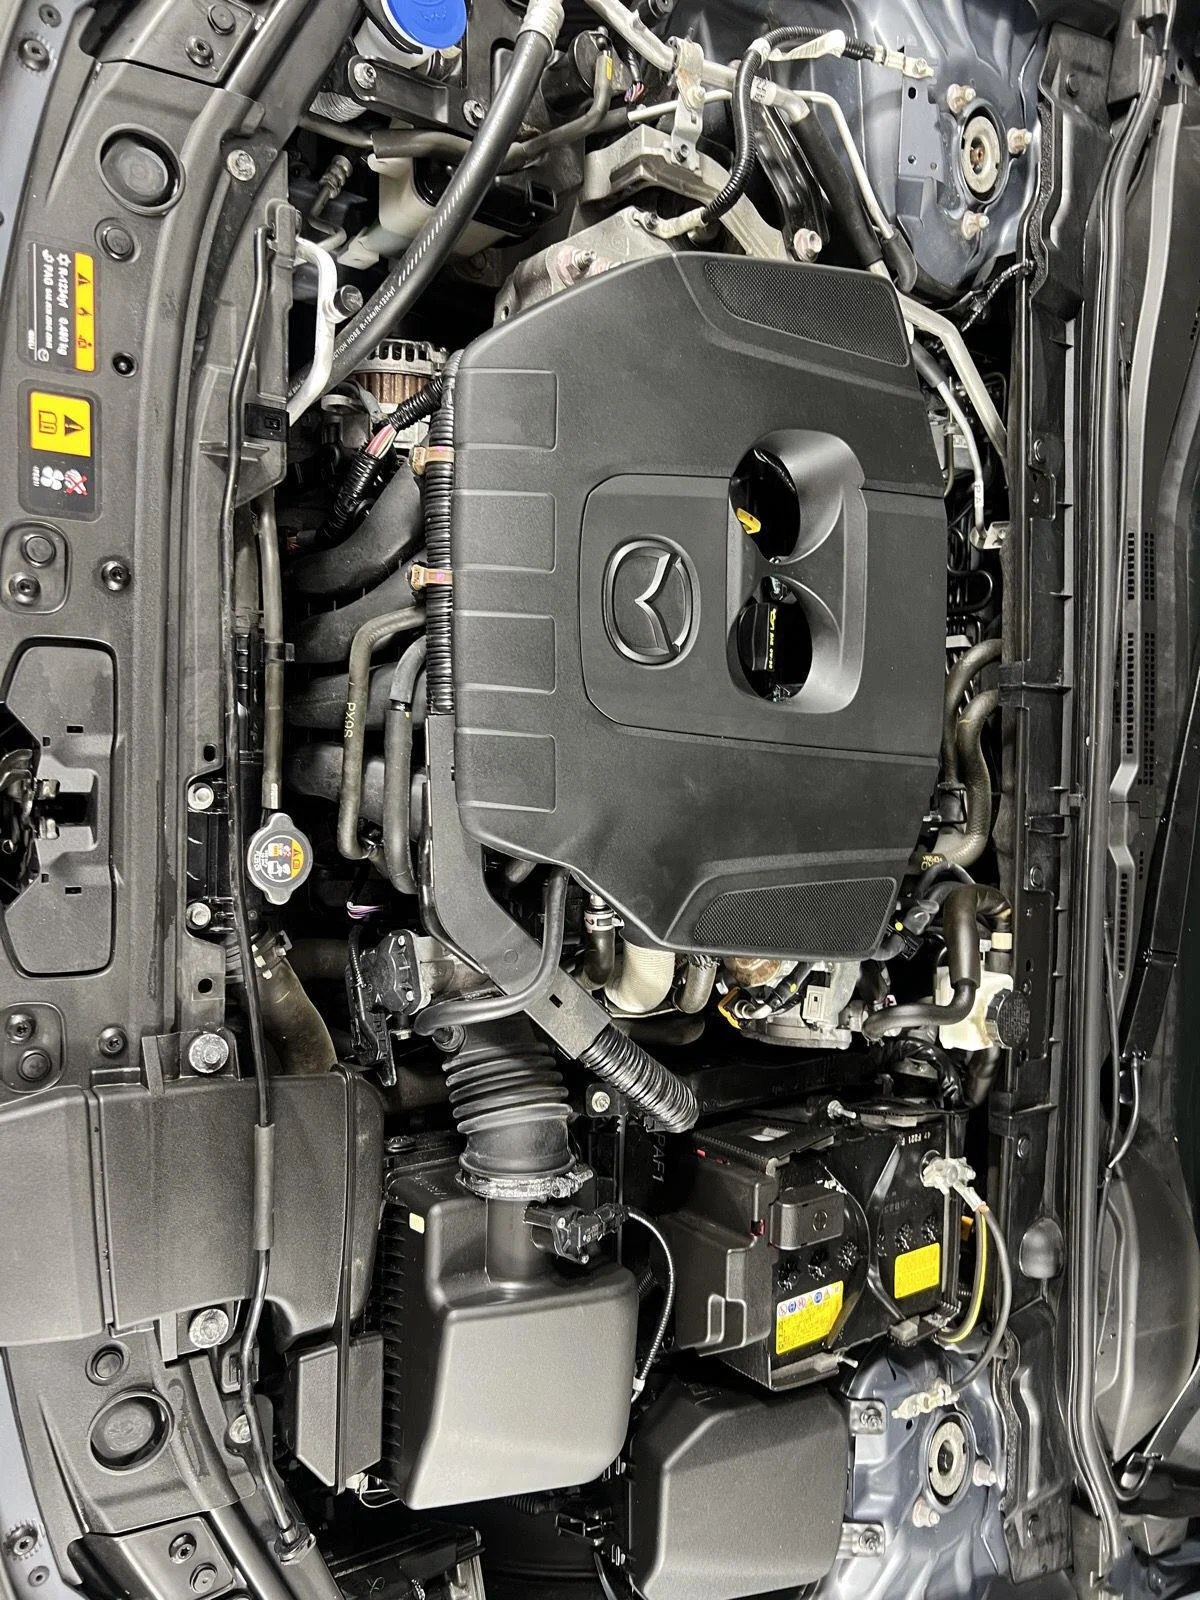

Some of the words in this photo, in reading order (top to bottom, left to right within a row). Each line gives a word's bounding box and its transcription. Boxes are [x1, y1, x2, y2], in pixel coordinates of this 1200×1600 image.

[43, 264, 54, 286] PAG
[346, 327, 361, 345] HOSE
[652, 1132, 666, 1183] PAF1
